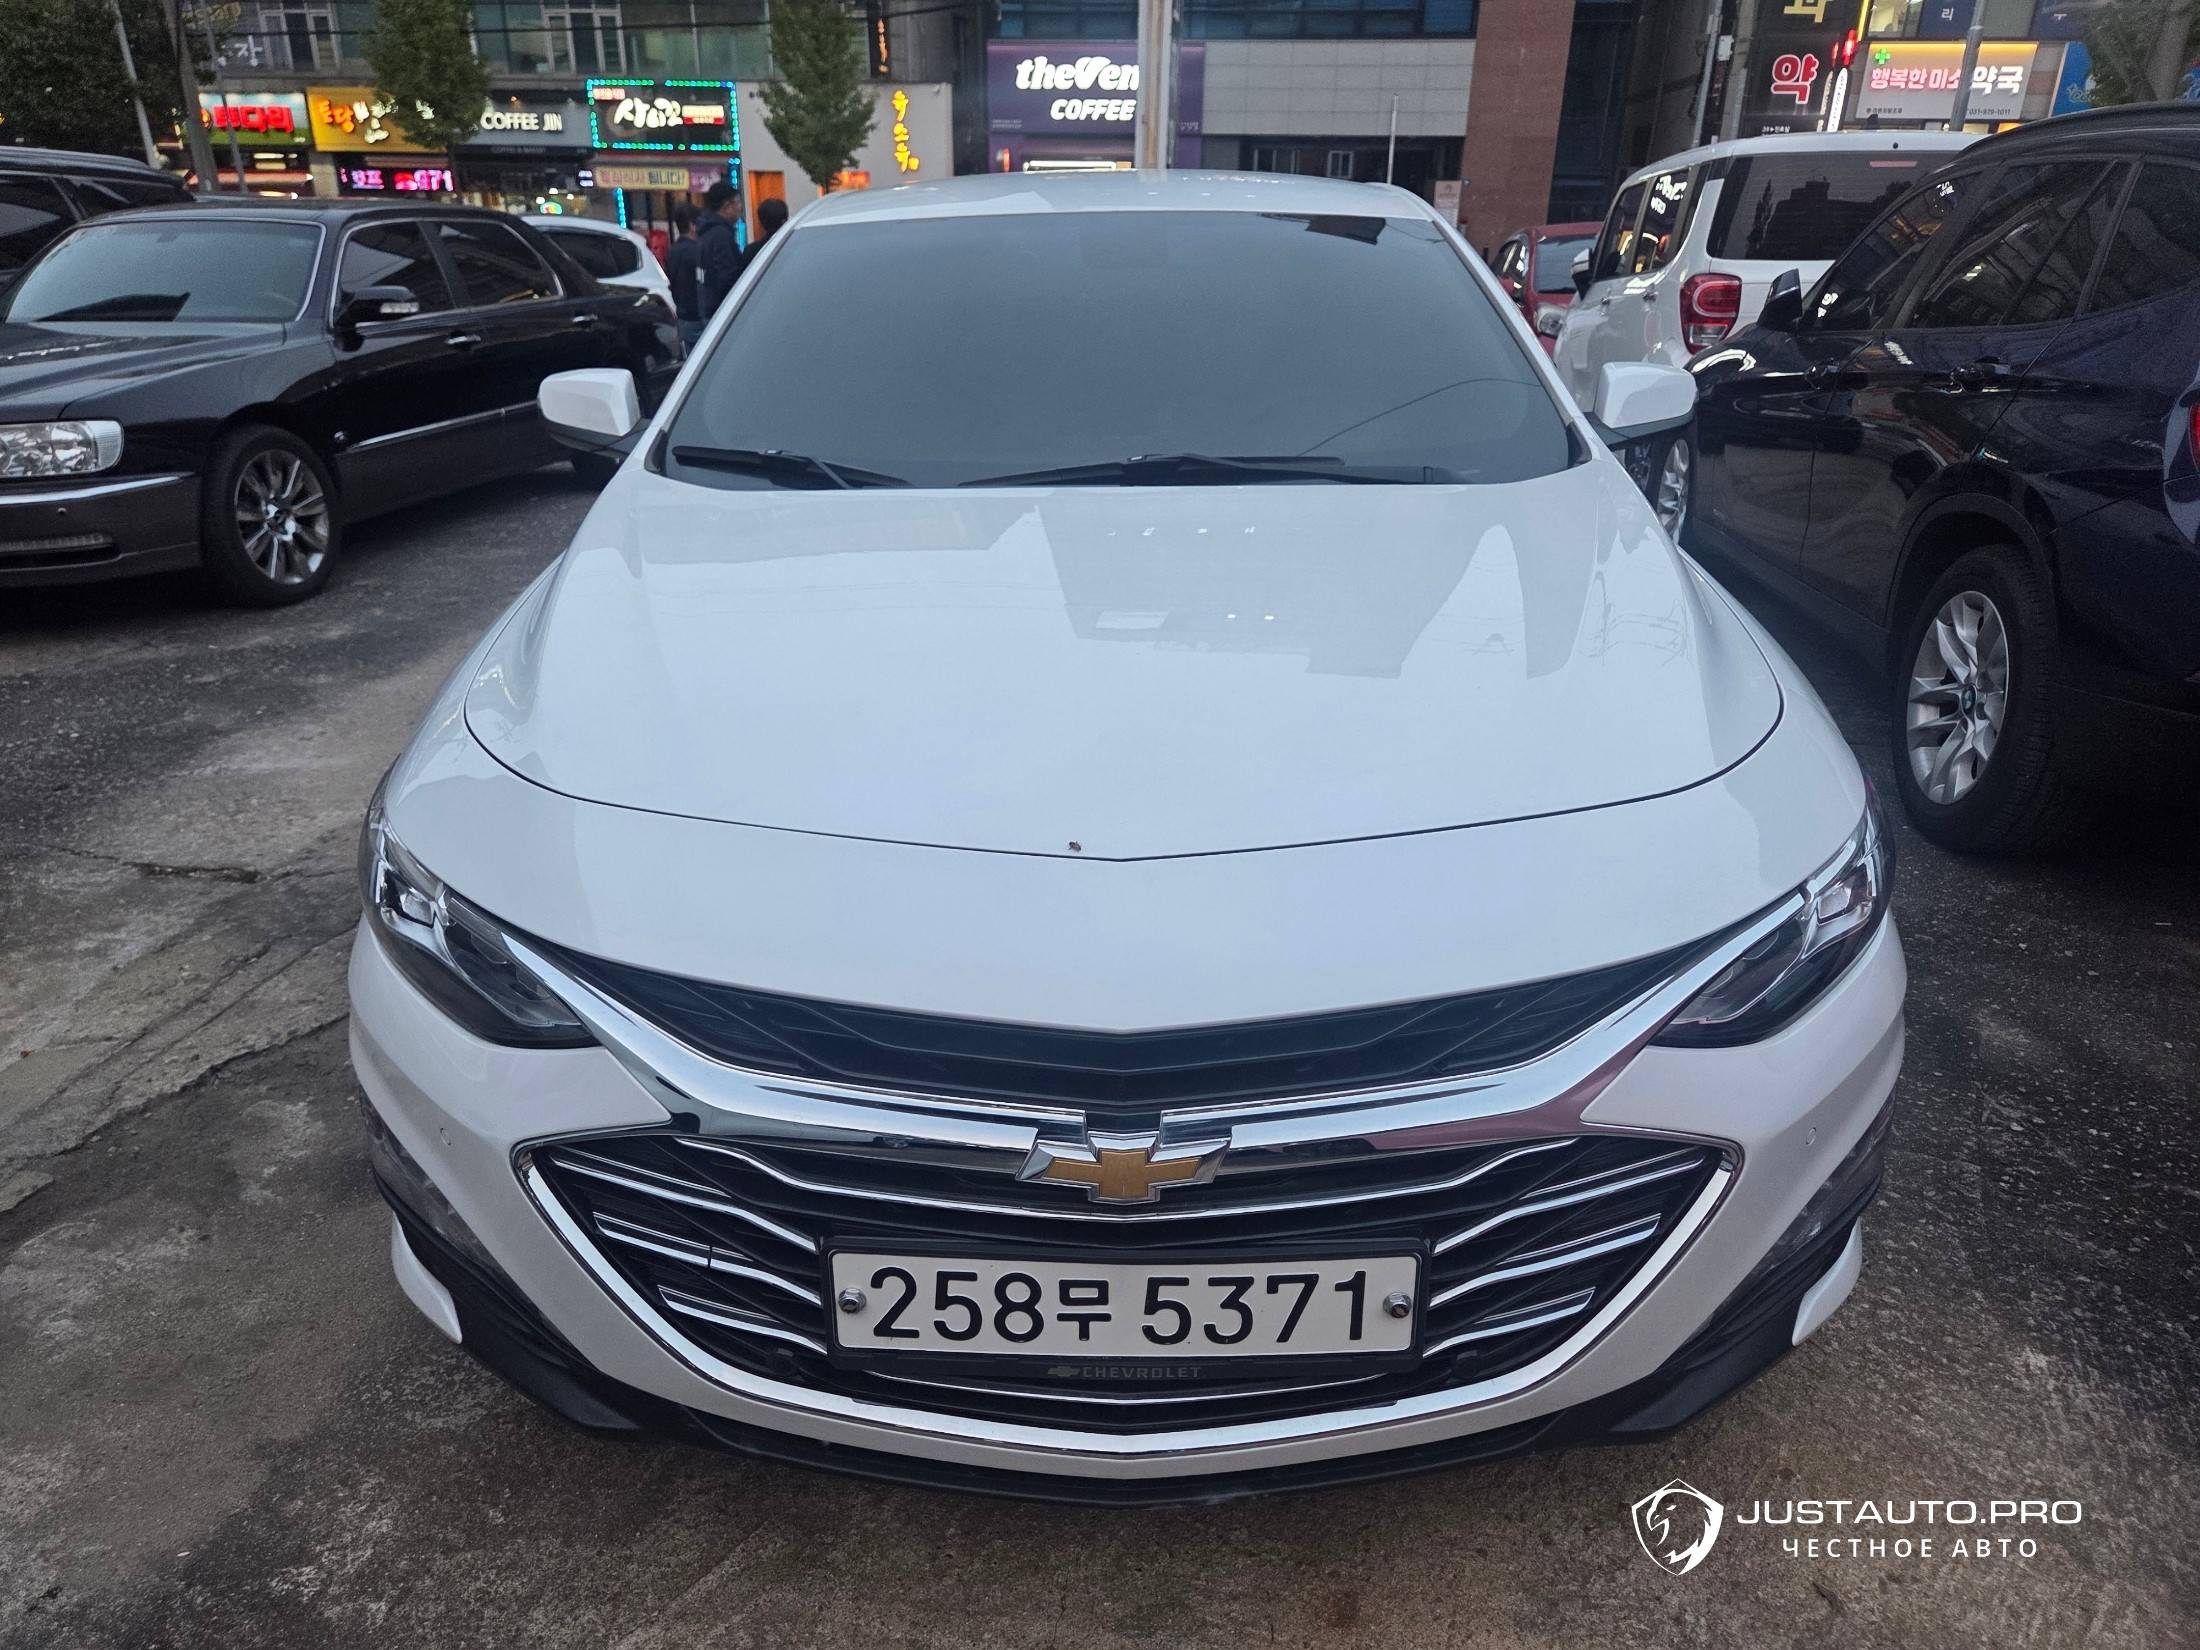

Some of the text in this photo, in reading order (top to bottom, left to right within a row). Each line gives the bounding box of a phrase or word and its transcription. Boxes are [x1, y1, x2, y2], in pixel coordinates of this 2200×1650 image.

[1016, 56, 1140, 91] theVen
[1770, 53, 1820, 105] 약
[1870, 67, 1927, 90] 행복한
[1970, 65, 2024, 95] 약국
[480, 111, 563, 131] COFFEE JIN
[1050, 98, 1137, 121] COFFEE
[870, 1266, 1368, 1346] 258무 5371
[1082, 1365, 1203, 1379] CHEVROLET
